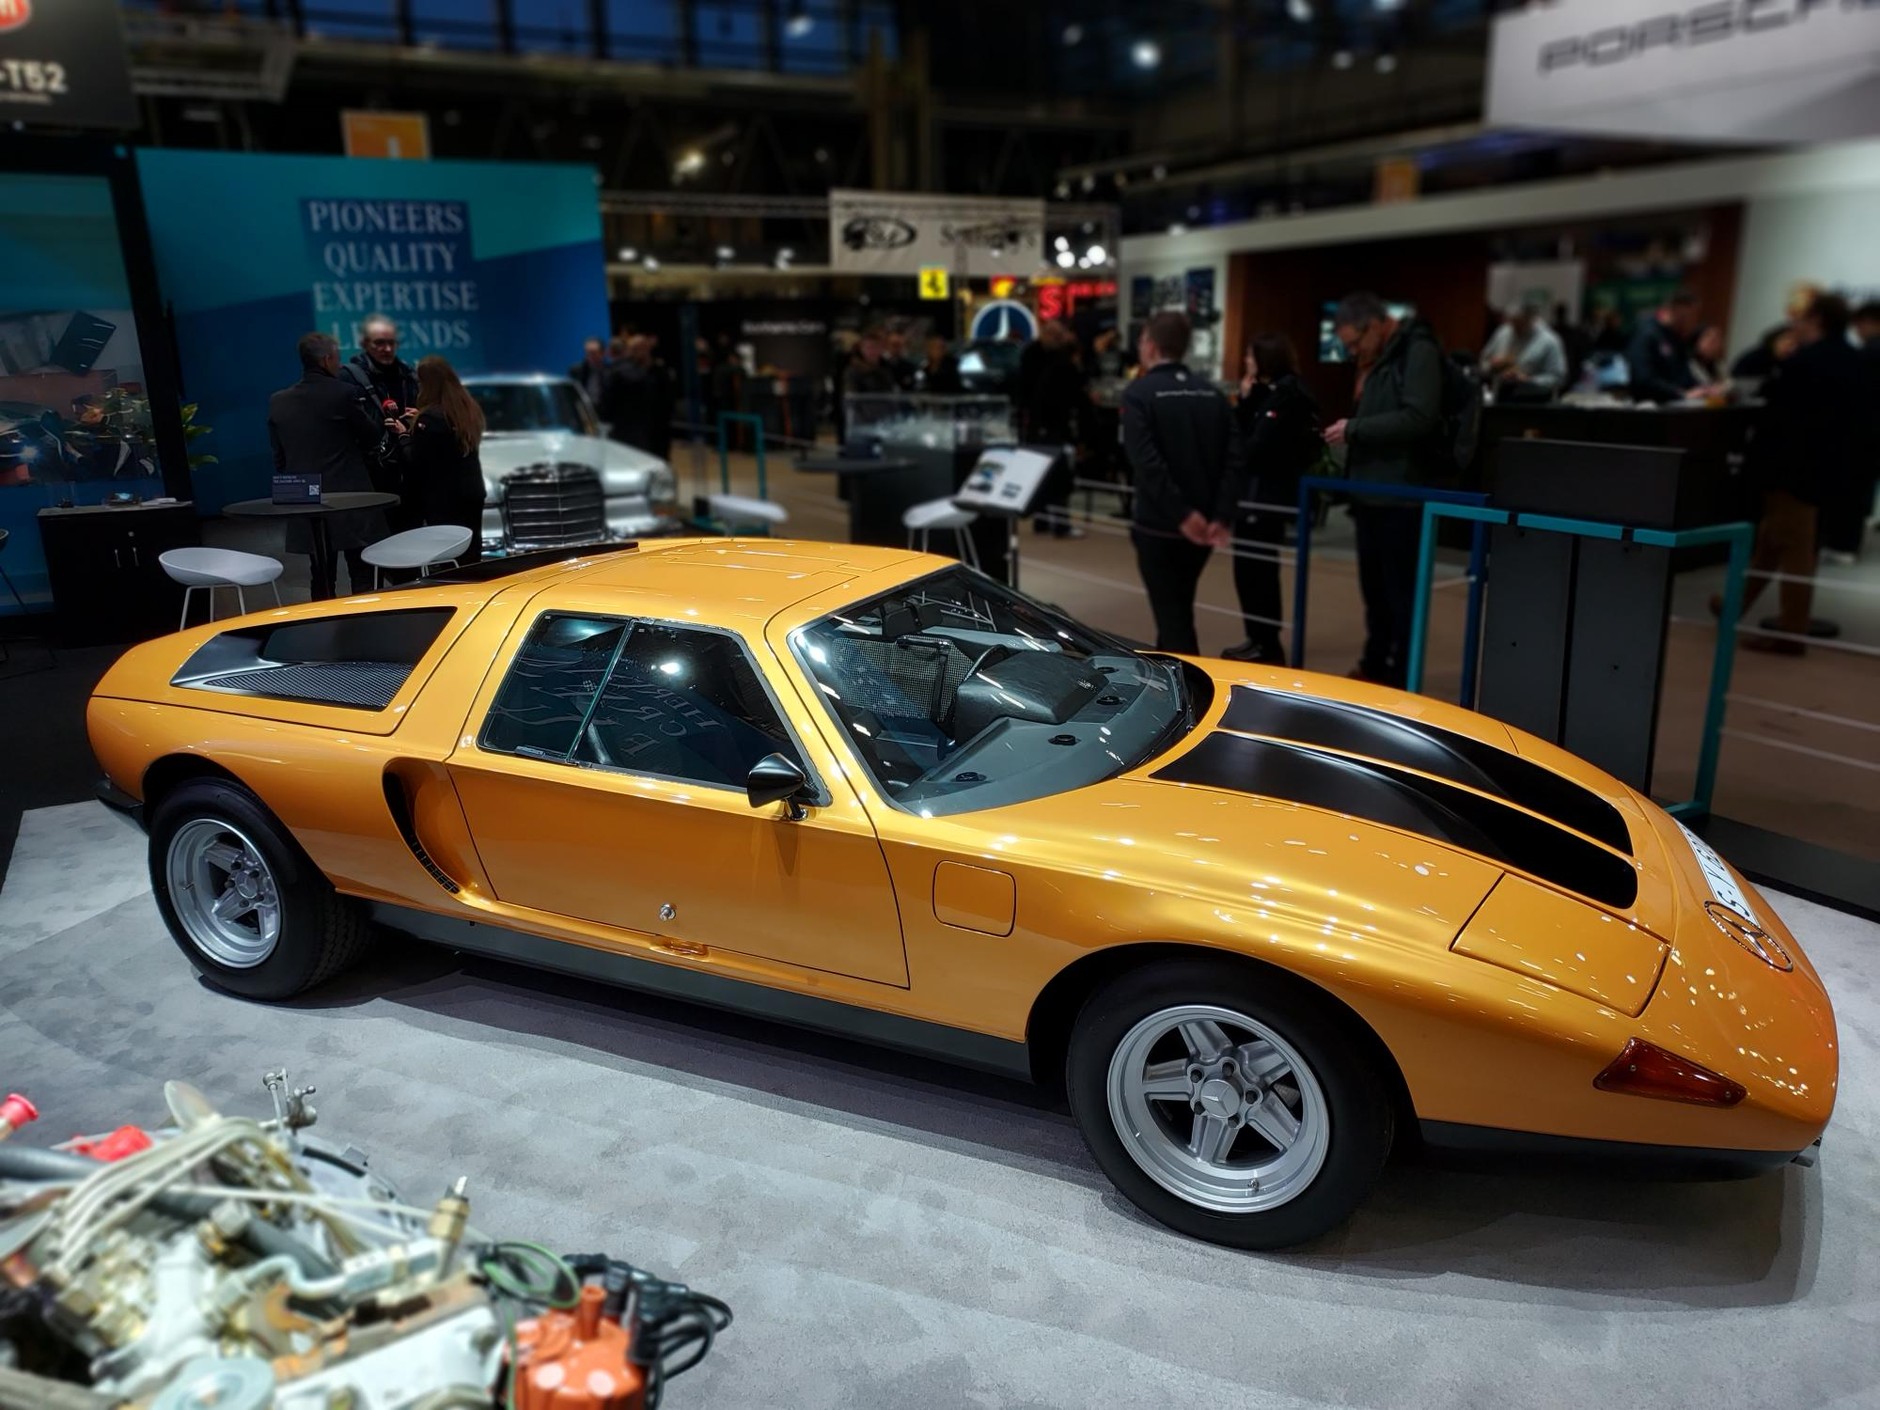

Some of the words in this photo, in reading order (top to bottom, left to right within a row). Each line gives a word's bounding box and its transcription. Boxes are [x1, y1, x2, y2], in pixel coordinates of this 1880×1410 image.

[1539, 0, 1880, 74] PORSC
[309, 201, 464, 234] PIONEERS
[323, 241, 458, 278] QUALITY
[312, 280, 479, 312] EXPERTISE
[331, 319, 472, 350] LEENDS
